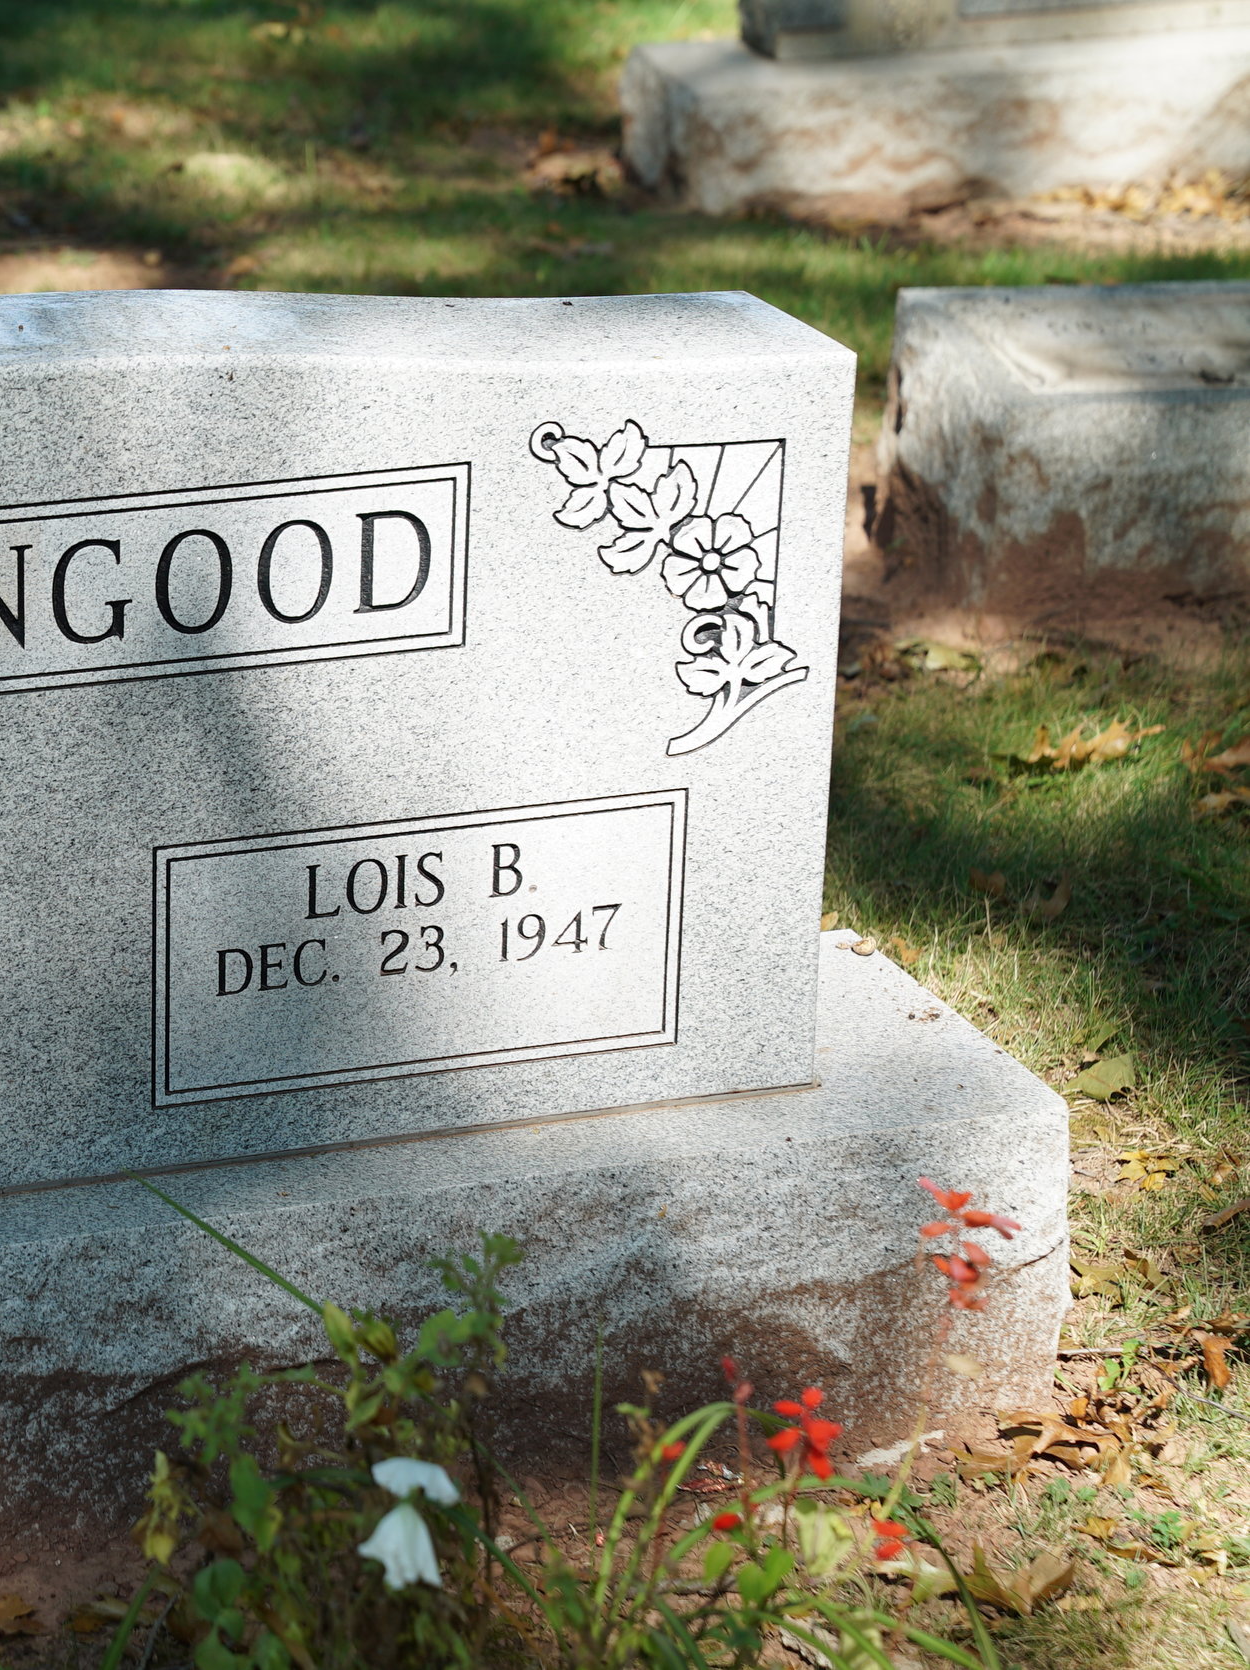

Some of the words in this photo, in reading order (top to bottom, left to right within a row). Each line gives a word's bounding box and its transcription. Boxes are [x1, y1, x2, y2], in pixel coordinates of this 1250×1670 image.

[305, 851, 445, 920] LOIS
[488, 842, 538, 899] B.
[215, 938, 340, 997] DEC.
[380, 925, 458, 976] 23,
[499, 903, 622, 962] 1947
